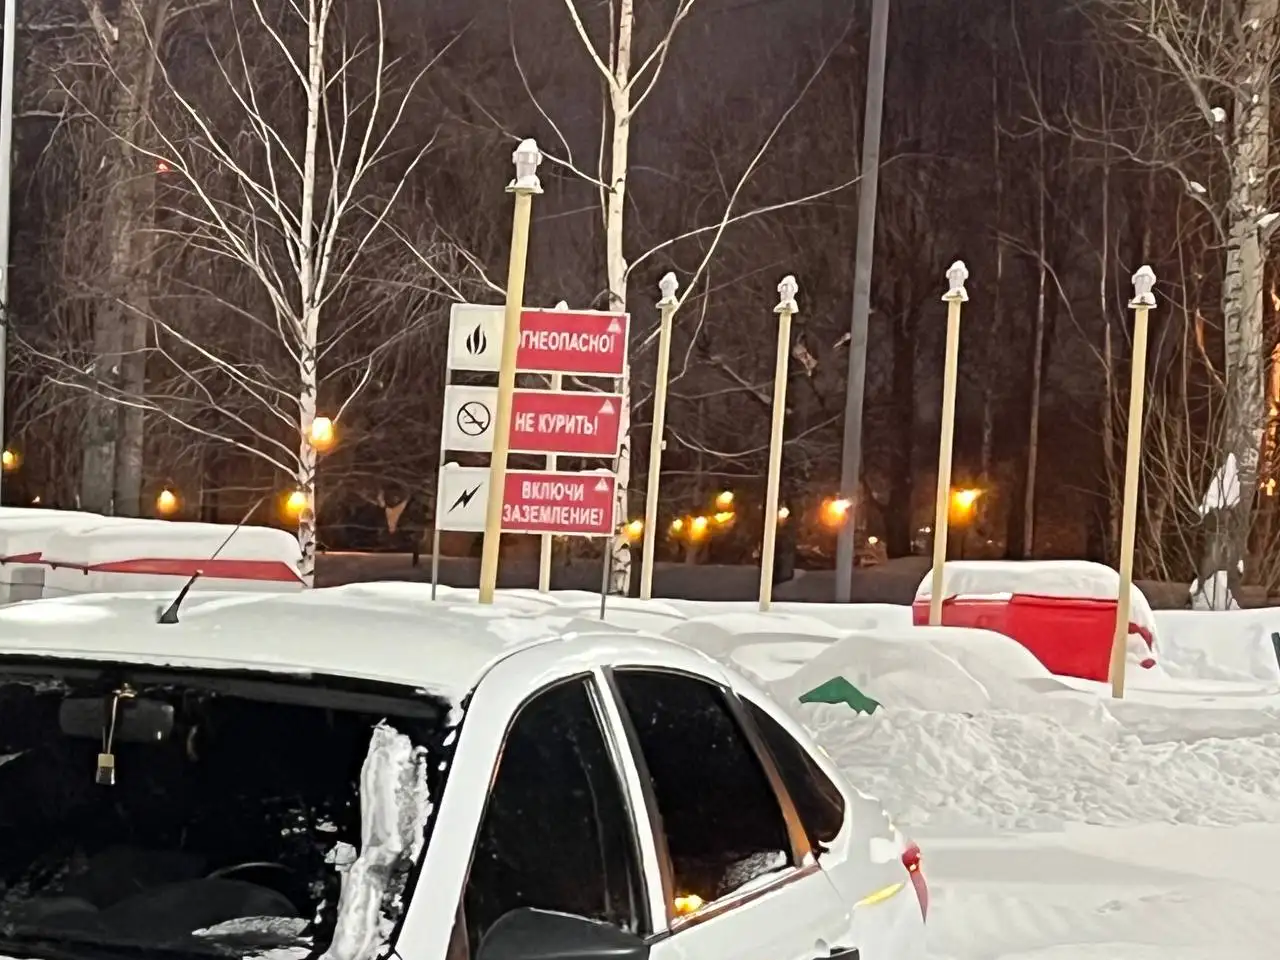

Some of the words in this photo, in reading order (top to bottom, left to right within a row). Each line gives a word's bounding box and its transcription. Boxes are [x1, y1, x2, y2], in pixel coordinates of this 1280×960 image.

[519, 330, 615, 354] ГНЕОПАСНО!
[515, 412, 534, 433] НЕ
[538, 412, 599, 436] КУРИТЬ!
[522, 481, 584, 501] ВКЛЮЧИ
[503, 505, 603, 526] ЗАЗЕМЛЕНИЕ!
